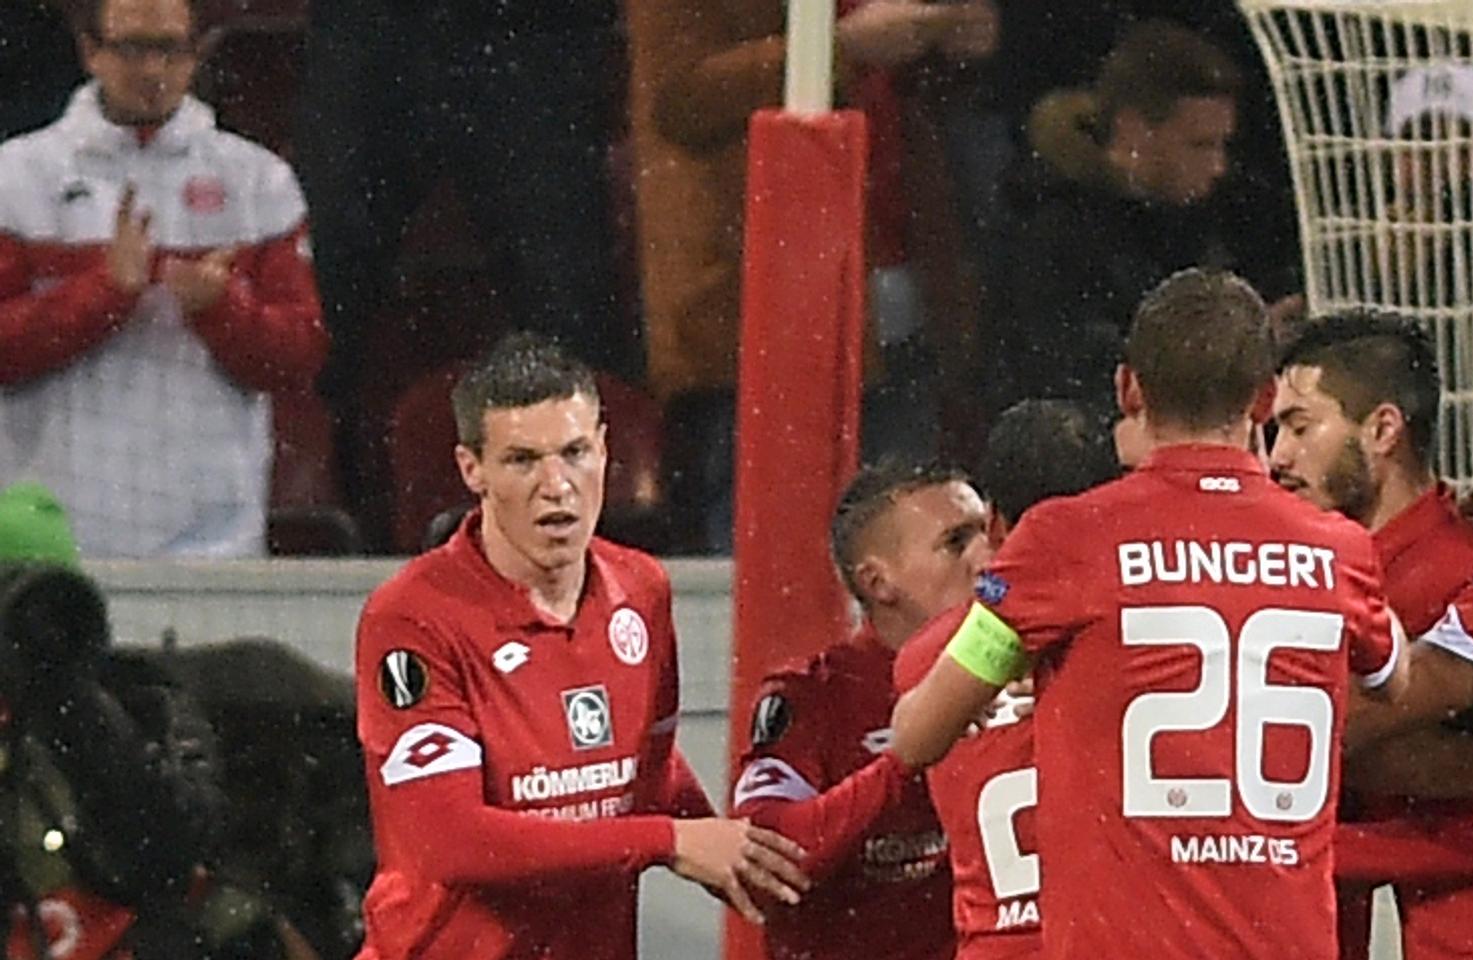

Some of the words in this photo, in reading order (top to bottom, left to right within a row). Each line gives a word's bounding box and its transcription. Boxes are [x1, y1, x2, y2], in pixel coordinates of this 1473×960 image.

[1118, 539, 1336, 590] BUNGERT
[1120, 605, 1345, 821] 26
[1170, 835, 1267, 863] MAINZ
